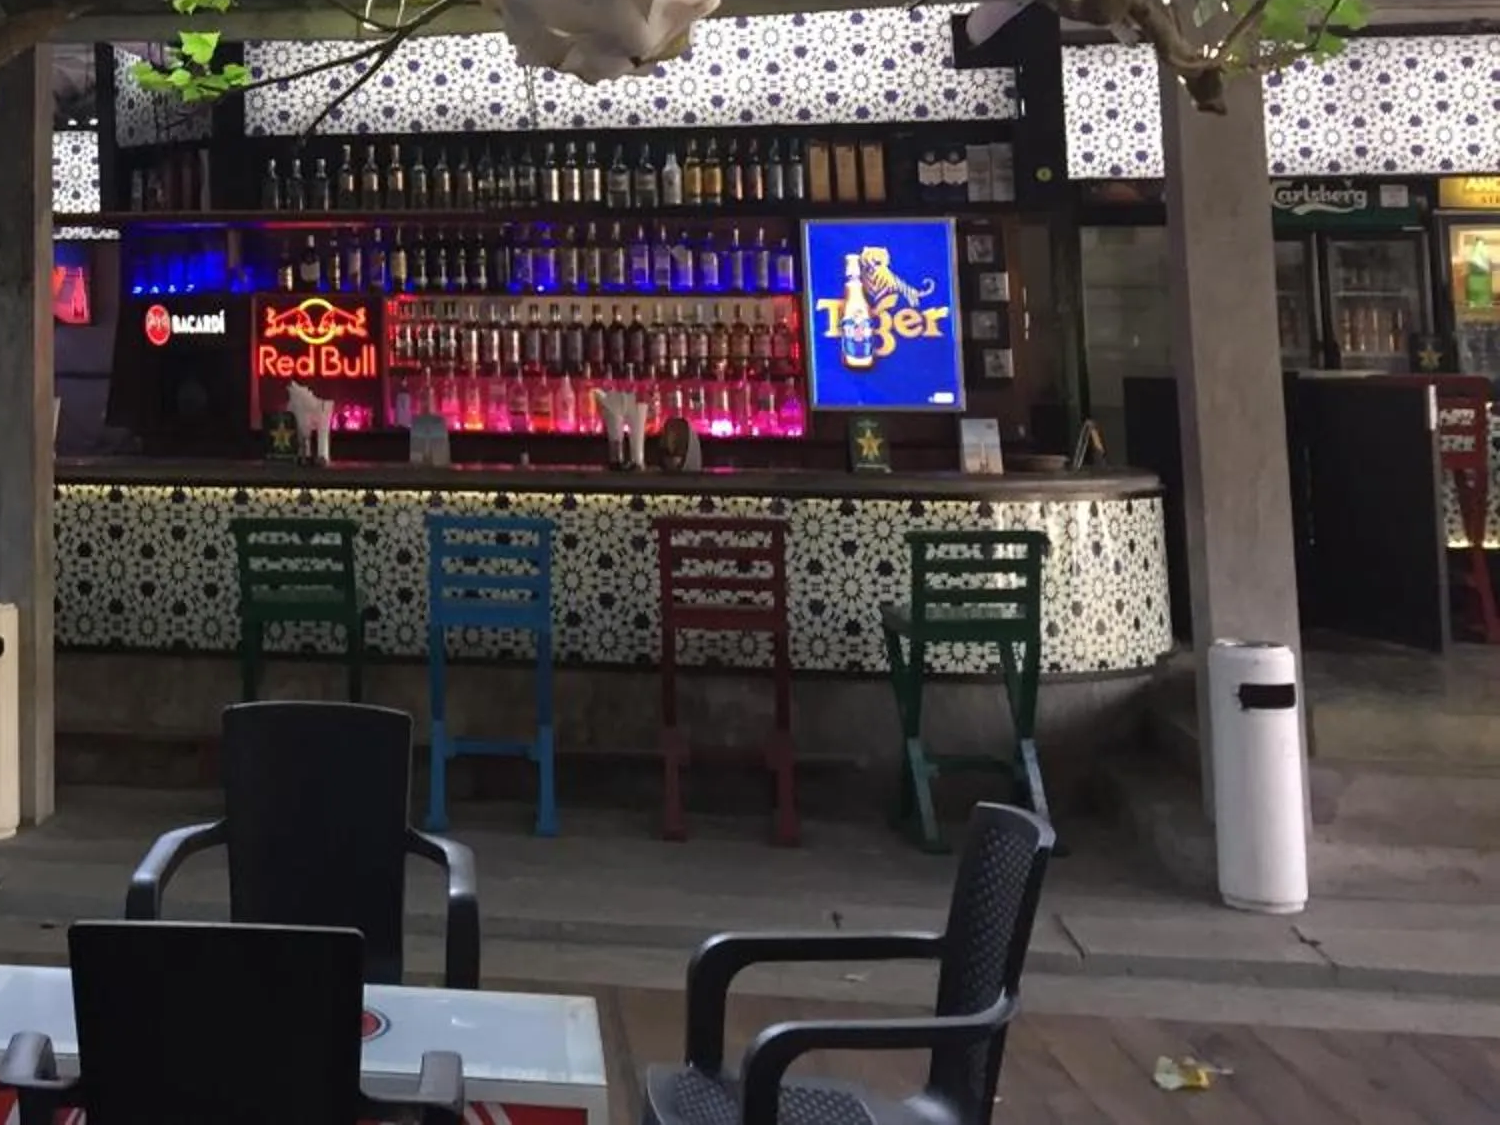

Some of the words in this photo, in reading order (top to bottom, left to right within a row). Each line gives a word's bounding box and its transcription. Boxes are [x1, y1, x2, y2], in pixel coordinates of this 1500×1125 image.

[1271, 179, 1368, 211] Carlsberg
[816, 293, 949, 356] Tger
[259, 344, 315, 377] Red
[320, 343, 376, 377] Bull
